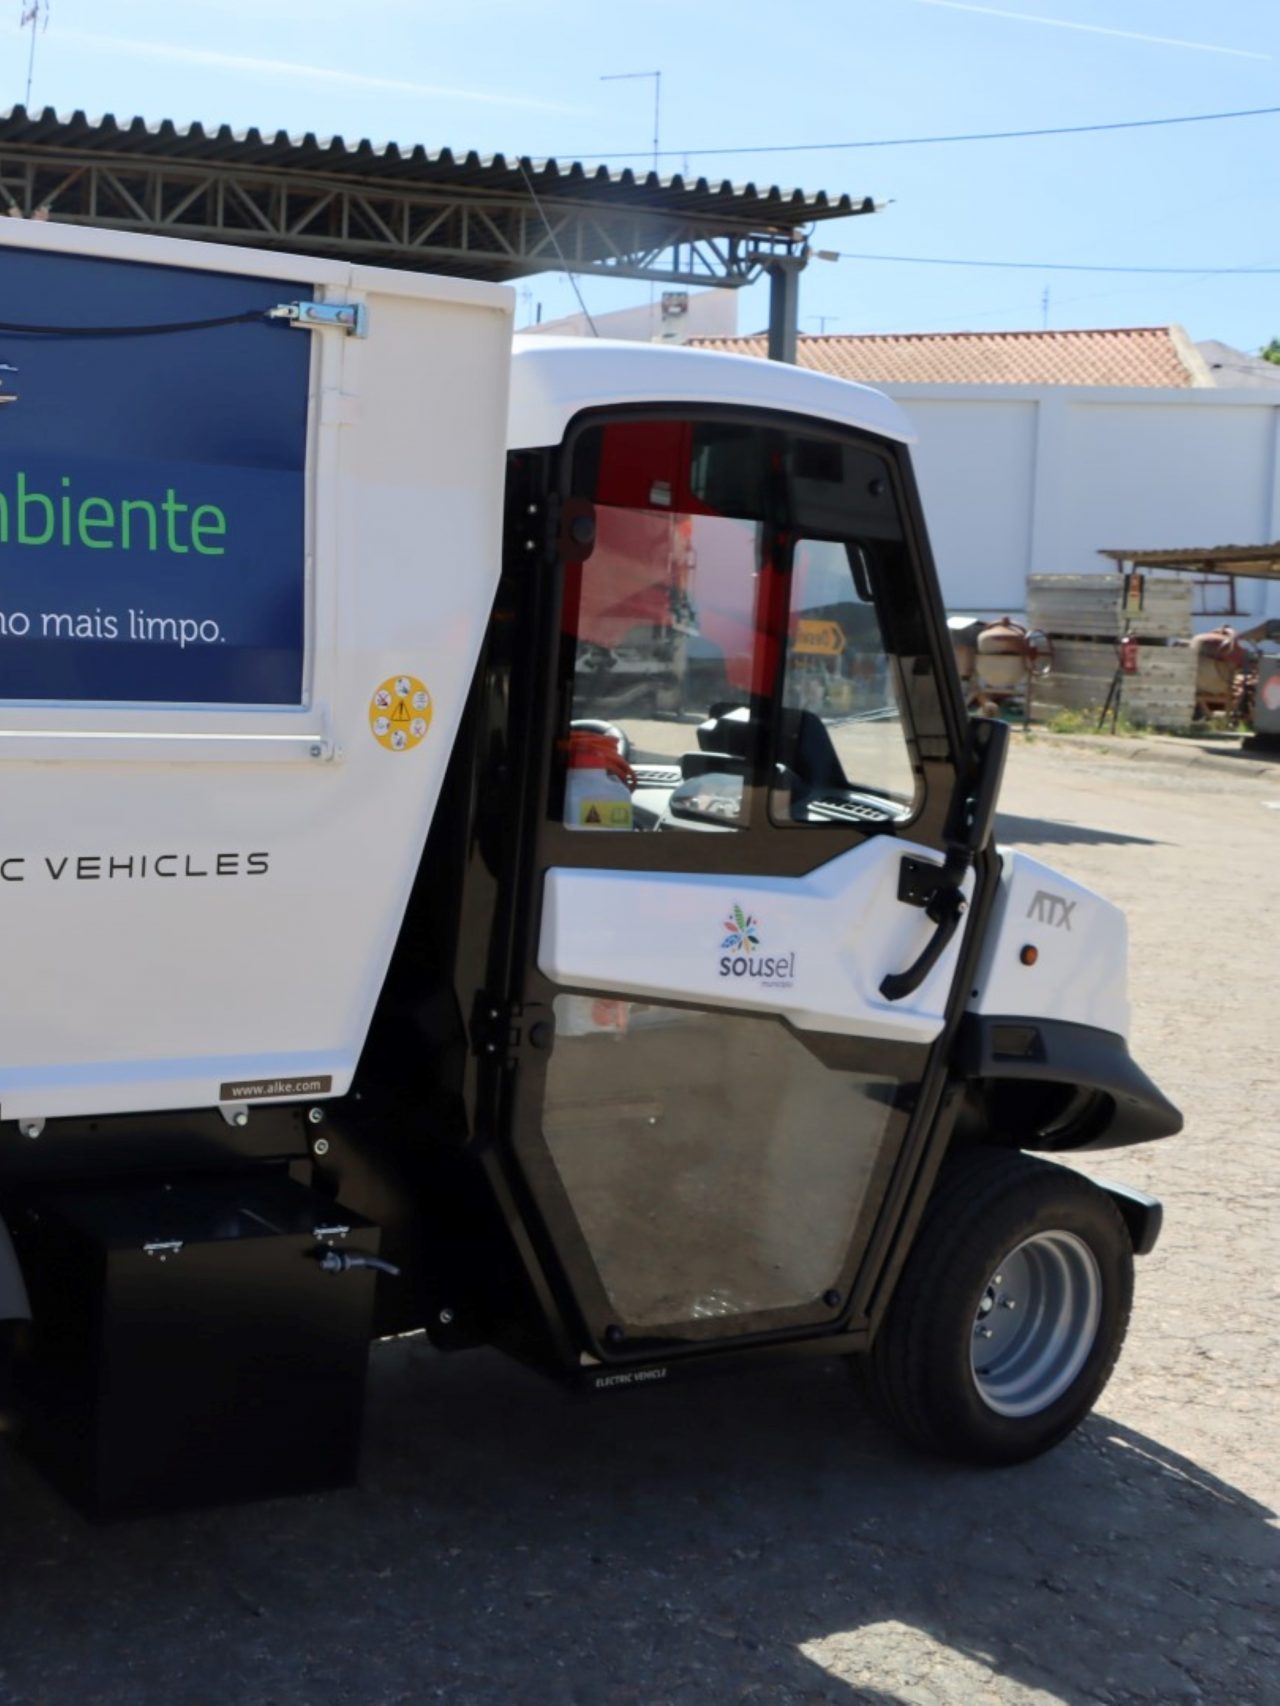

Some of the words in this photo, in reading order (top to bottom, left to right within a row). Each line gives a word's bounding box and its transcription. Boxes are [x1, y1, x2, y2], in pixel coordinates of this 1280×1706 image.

[42, 607, 118, 639] mais
[129, 609, 227, 648] limpo.
[45, 853, 269, 881] VEHICLES
[1026, 890, 1077, 931] ATX
[719, 951, 795, 978] sousel
[231, 1080, 322, 1097] www.alke.com
